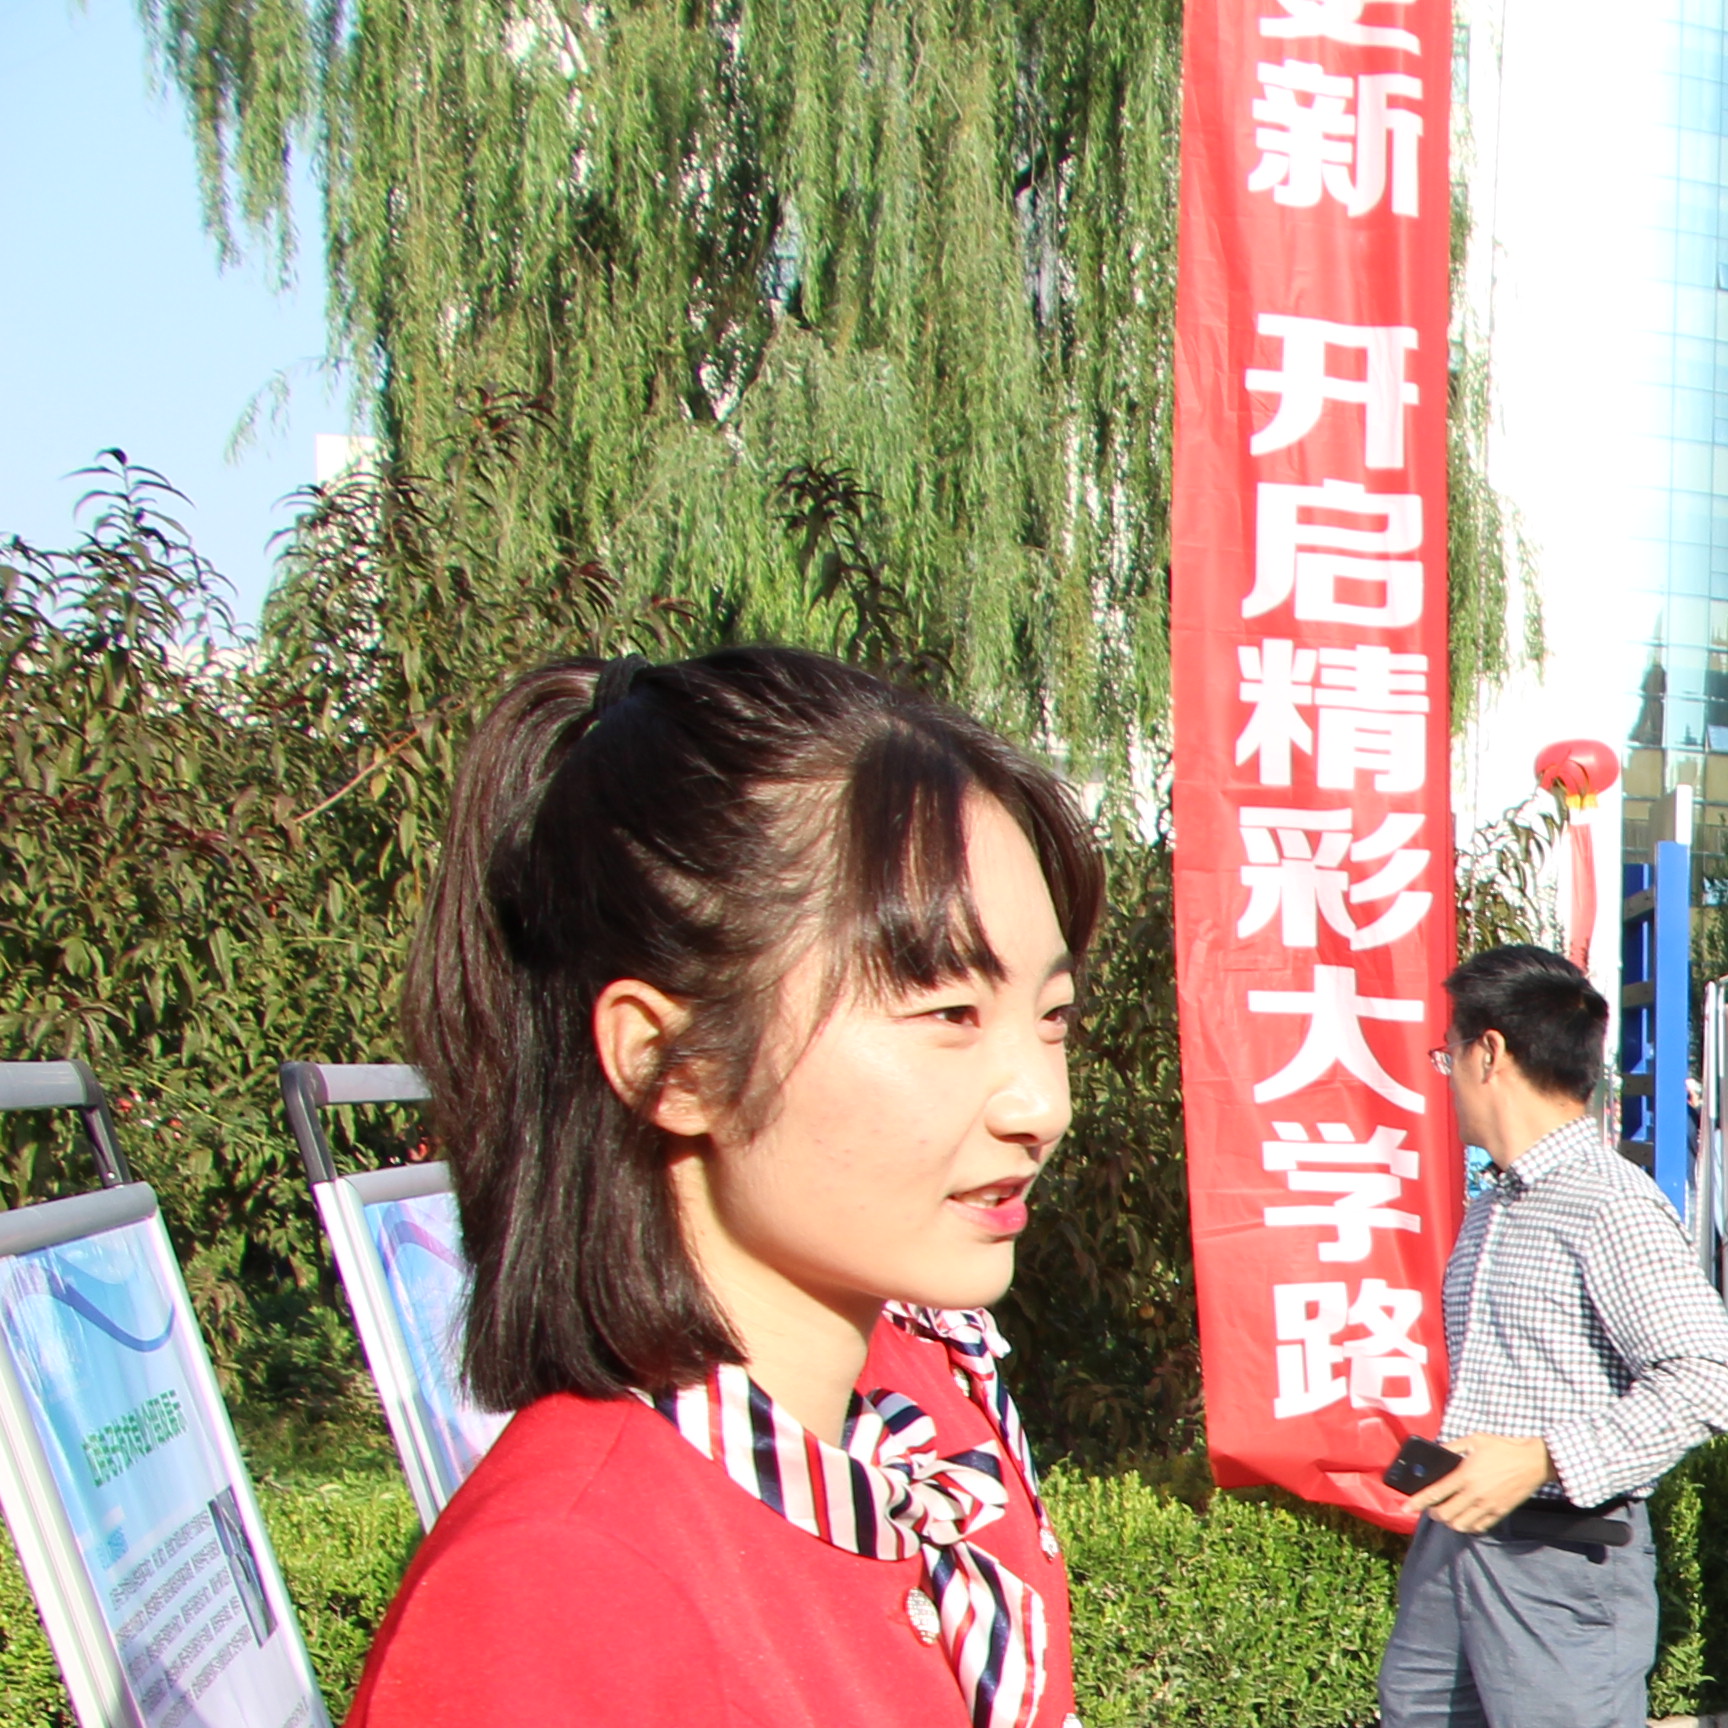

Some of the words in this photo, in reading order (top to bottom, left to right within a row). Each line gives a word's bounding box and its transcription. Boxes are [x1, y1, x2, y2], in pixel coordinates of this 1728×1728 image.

[1235, 312, 1433, 1420] 开启精彩大学路
